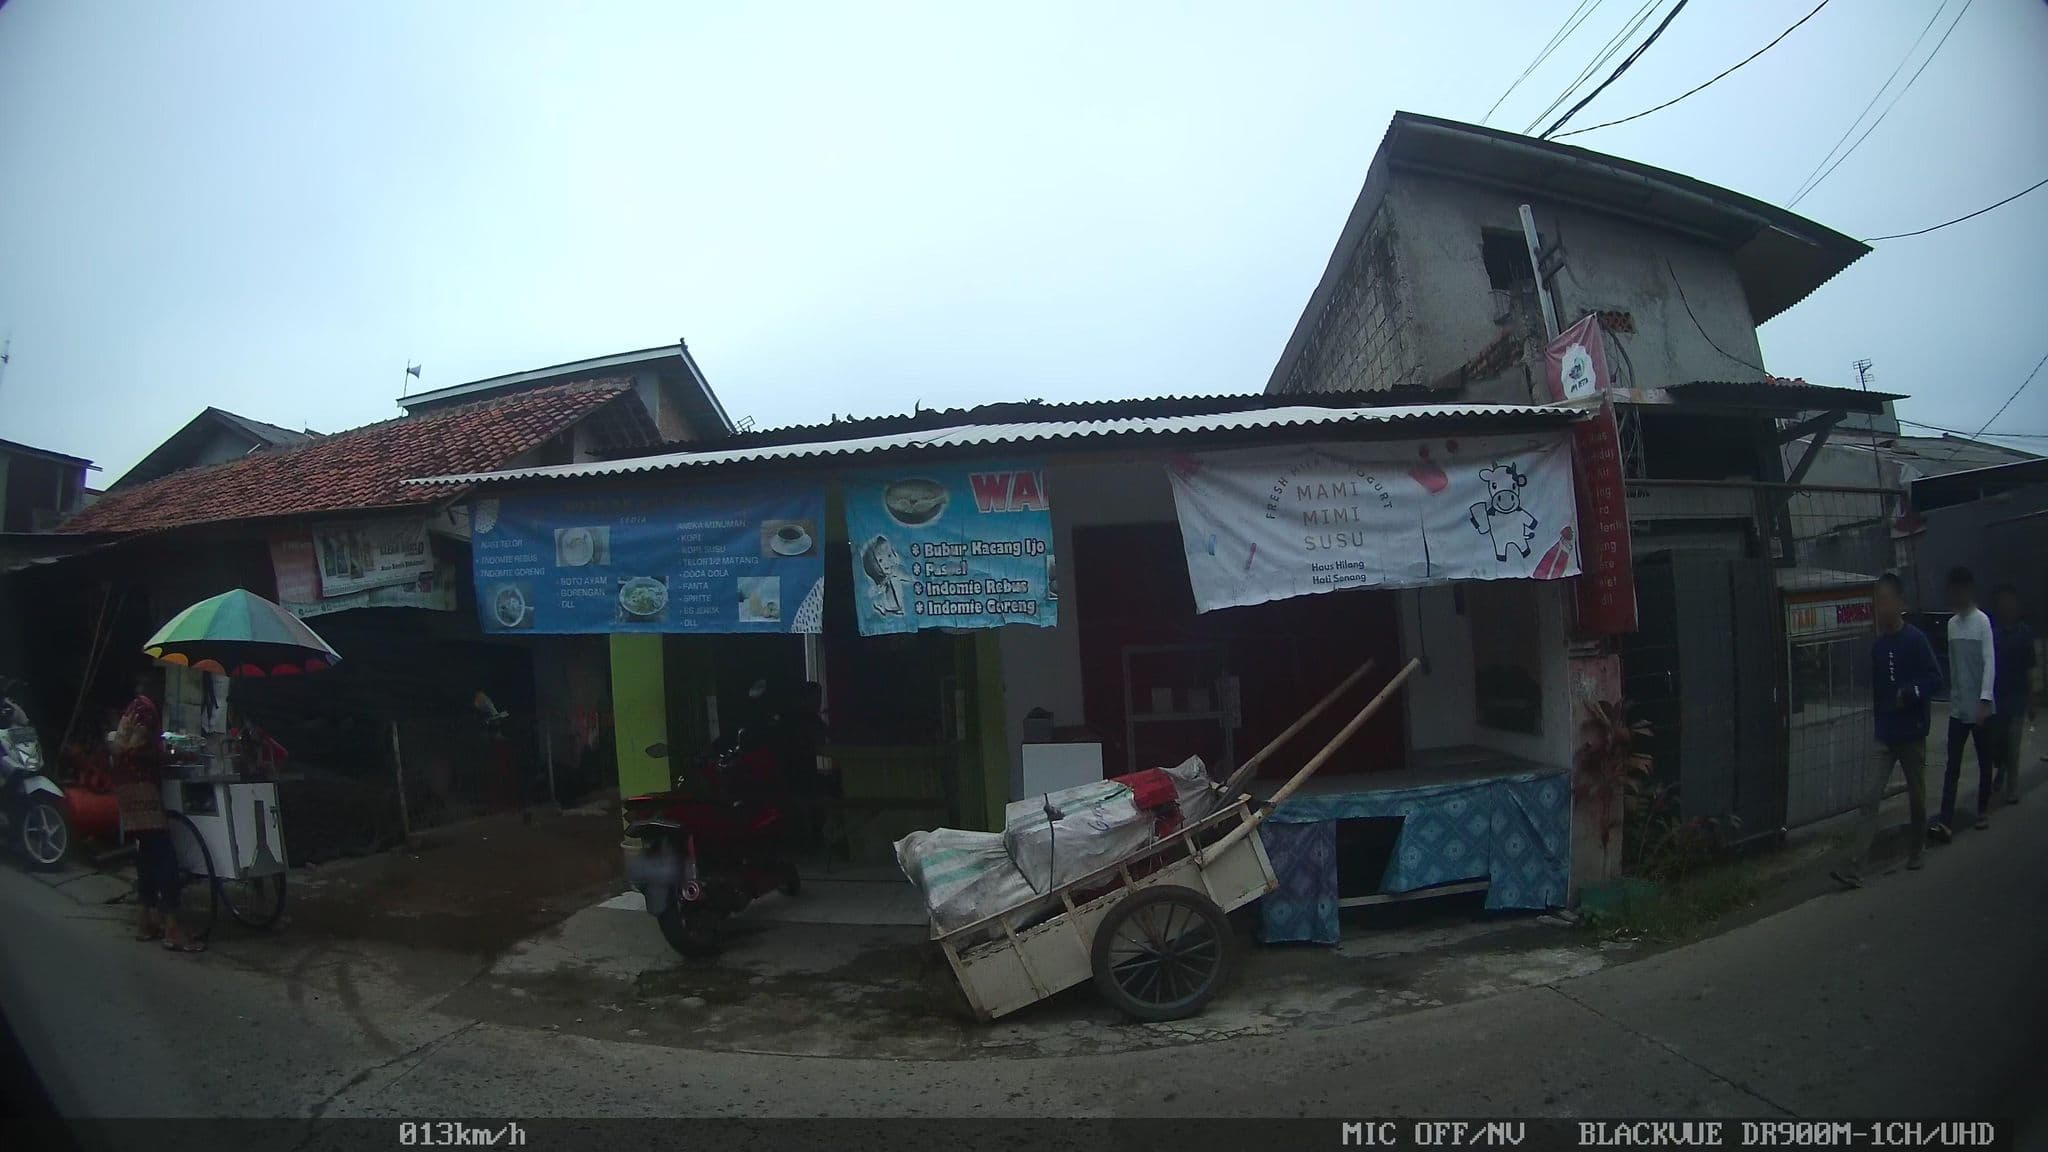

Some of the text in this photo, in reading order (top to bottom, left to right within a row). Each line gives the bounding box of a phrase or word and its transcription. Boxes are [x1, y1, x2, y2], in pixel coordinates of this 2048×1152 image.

[1266, 477, 1289, 519] FRESH
[1296, 481, 1361, 501] MAMI
[1302, 506, 1361, 527] MIMI
[924, 538, 1046, 558] Bubur Kacang Ijo
[1304, 531, 1364, 551] SUSU
[721, 556, 760, 566] MATANG
[1311, 560, 1365, 572] Haus Hilang
[683, 569, 729, 578] COCA COLA
[1333, 574, 1367, 583] Senang
[926, 578, 1029, 596] Indomie Rebus
[927, 598, 1037, 615] Indomie Goreng
